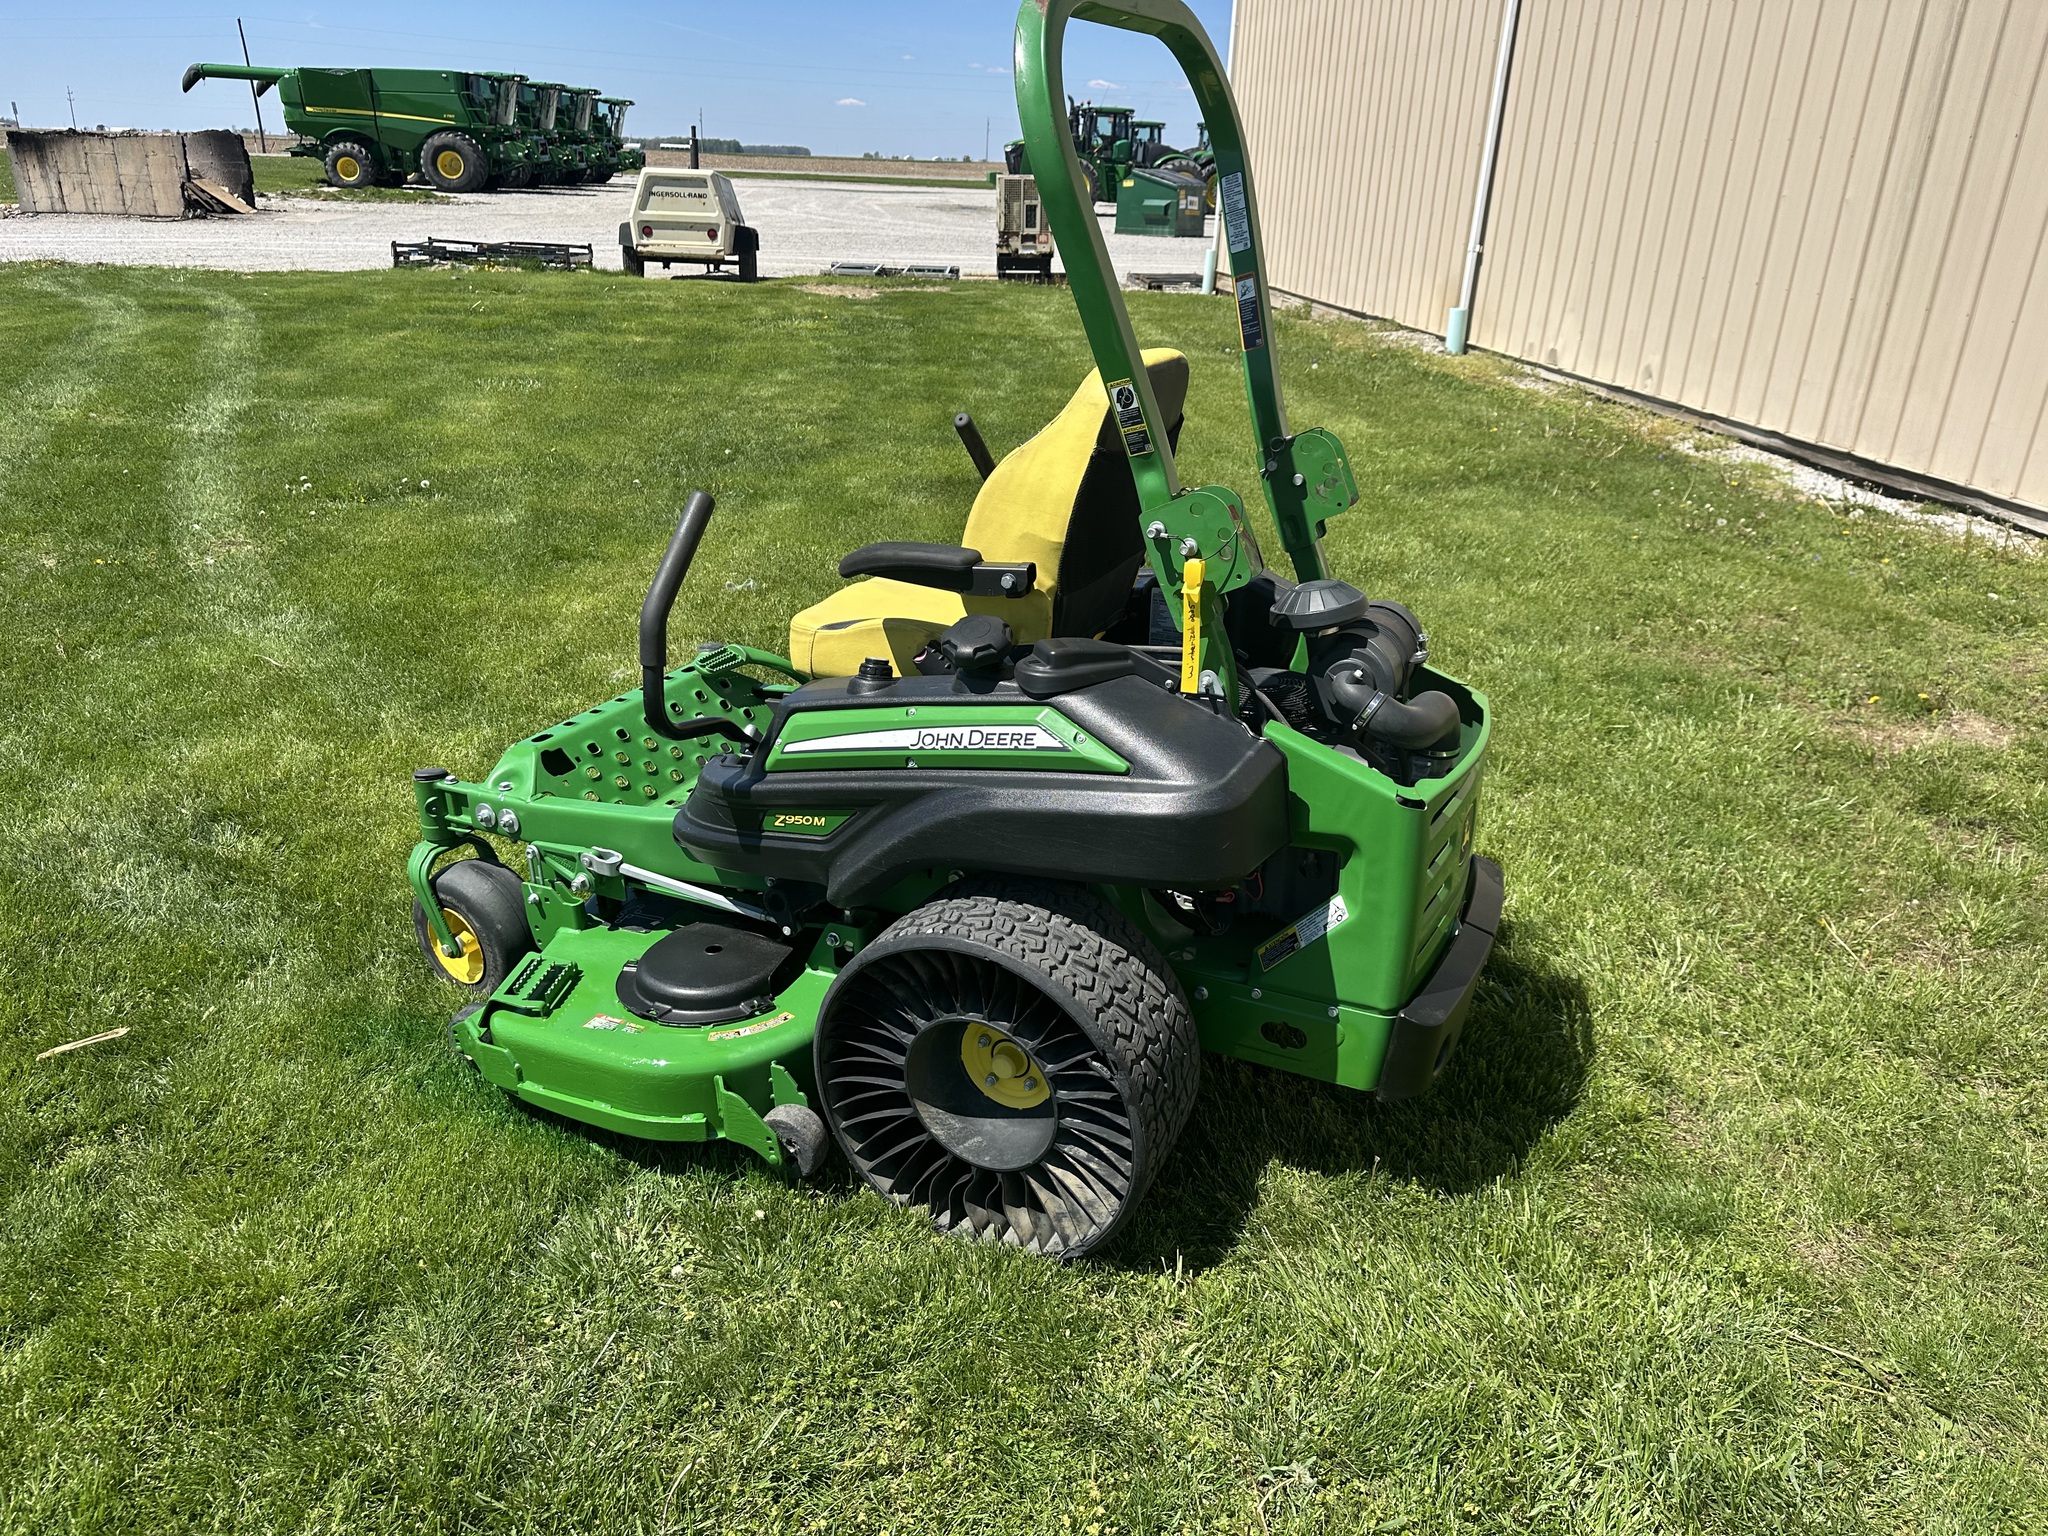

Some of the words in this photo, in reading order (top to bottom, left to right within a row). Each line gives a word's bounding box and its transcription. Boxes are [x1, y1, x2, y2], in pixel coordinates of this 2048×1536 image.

[648, 191, 708, 199] INGERSOLL-RAND
[909, 730, 965, 747] JOHN
[967, 729, 1037, 747] DEERE
[774, 814, 826, 827] Z950M
